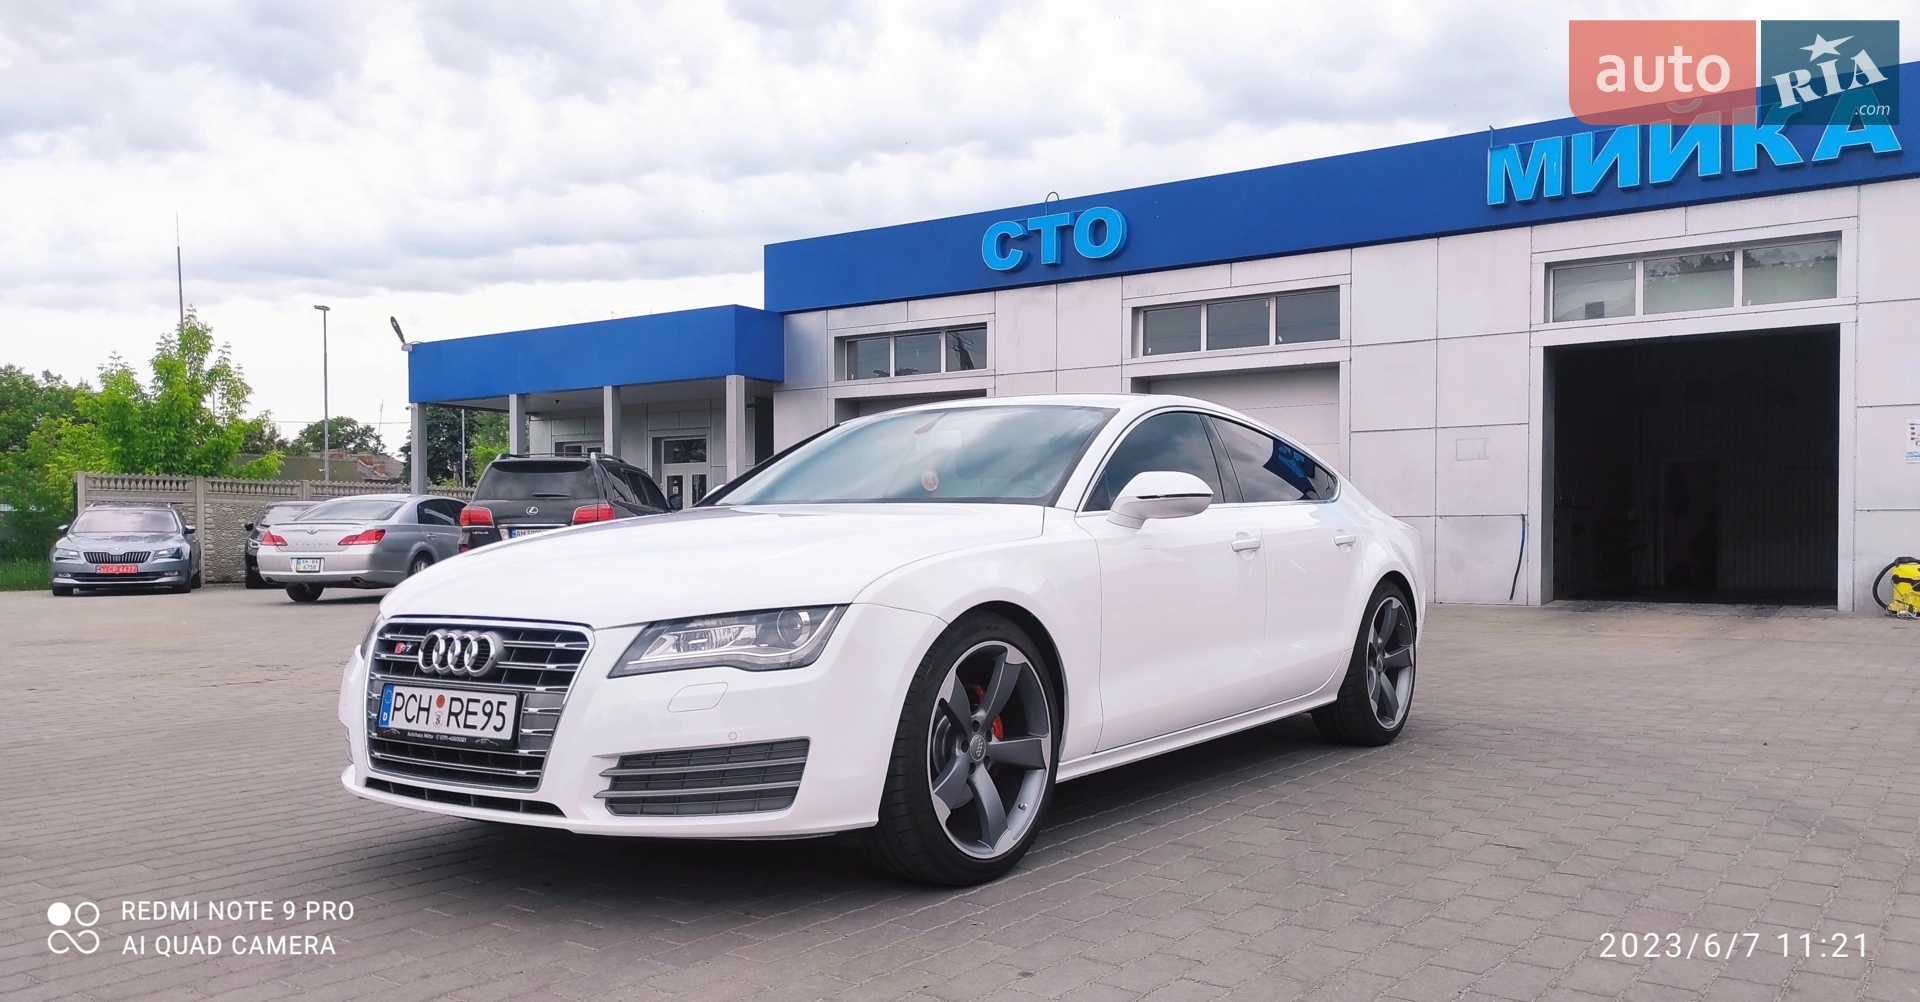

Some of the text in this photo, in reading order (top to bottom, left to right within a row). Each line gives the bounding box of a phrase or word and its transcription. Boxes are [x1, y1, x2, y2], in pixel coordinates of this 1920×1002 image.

[1487, 88, 1903, 206] МИЙКА
[982, 206, 1126, 271] СТО
[382, 712, 388, 721] D
[391, 691, 508, 733] PCH RE95
